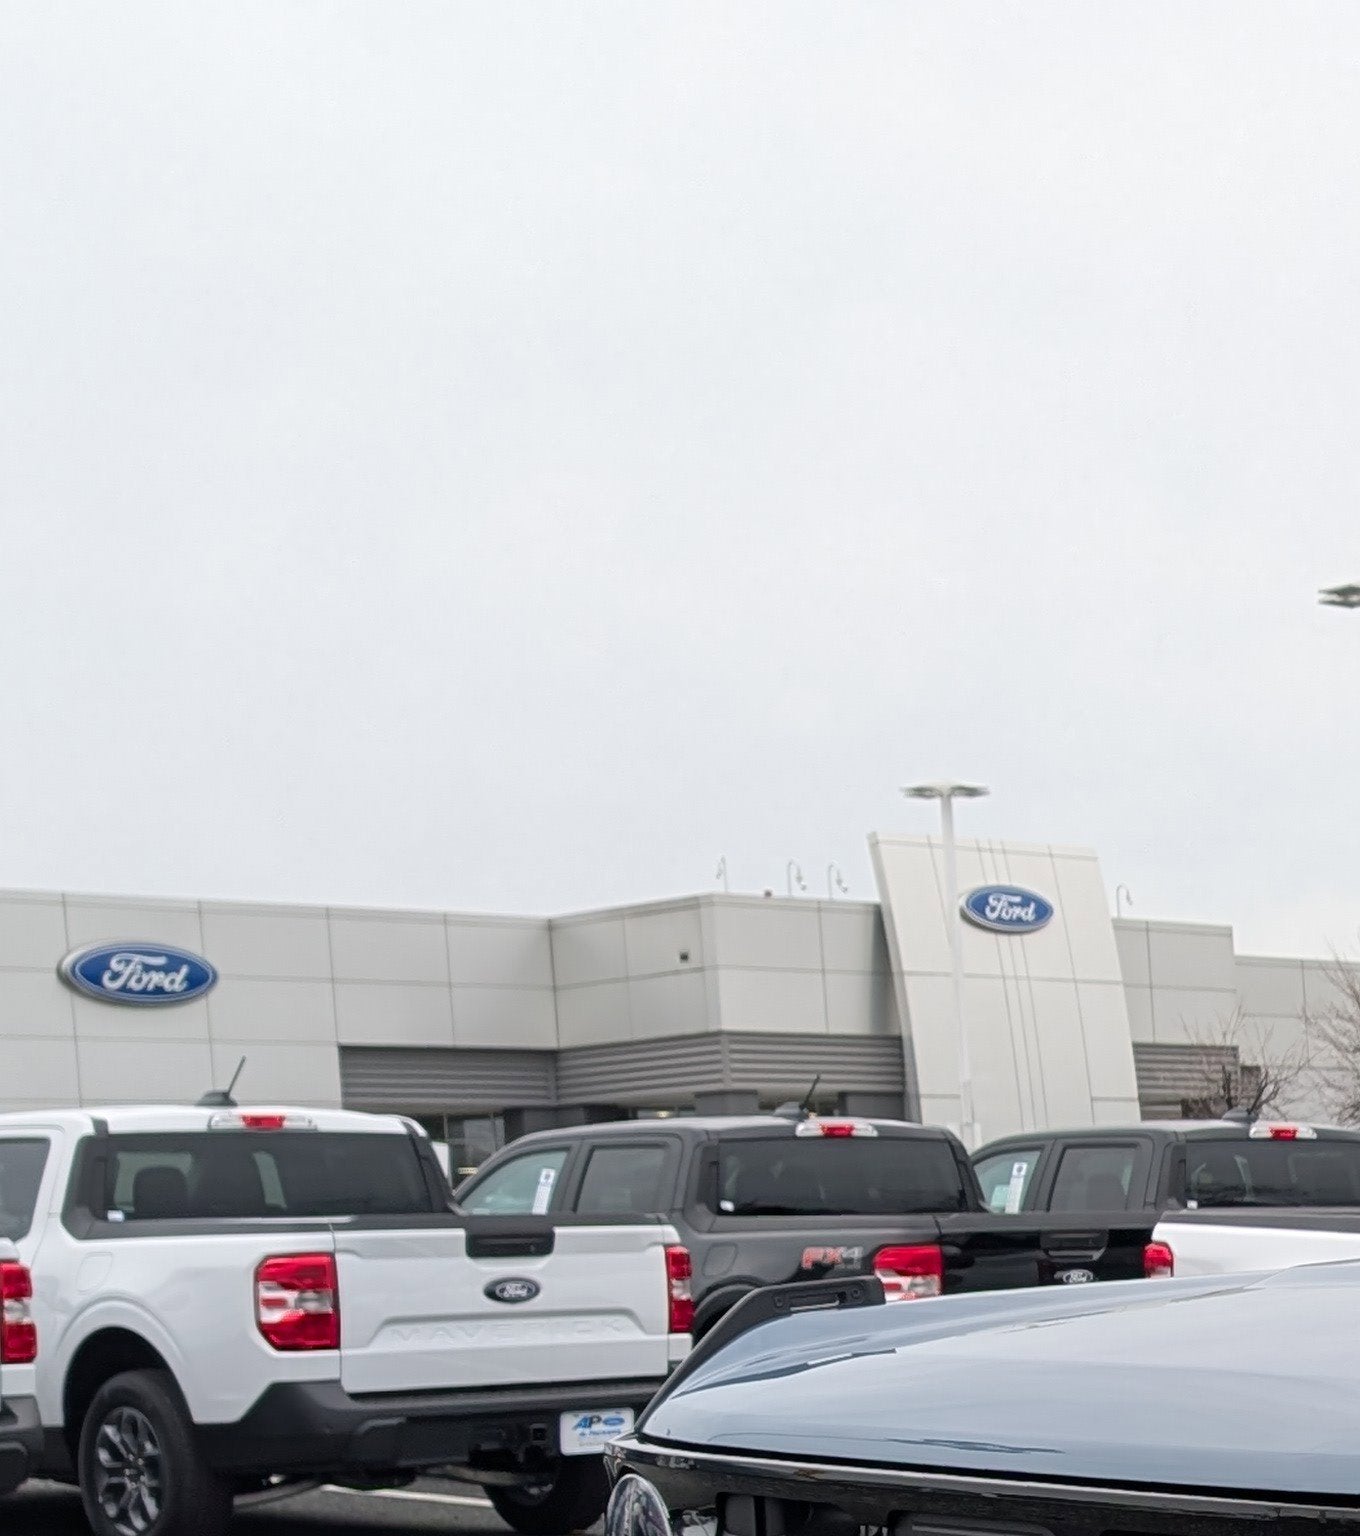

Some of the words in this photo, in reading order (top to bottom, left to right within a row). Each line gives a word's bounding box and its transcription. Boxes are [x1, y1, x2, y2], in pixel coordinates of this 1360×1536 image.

[985, 893, 1034, 921] Ford
[102, 952, 190, 992] Ford
[802, 1246, 863, 1270] FX4
